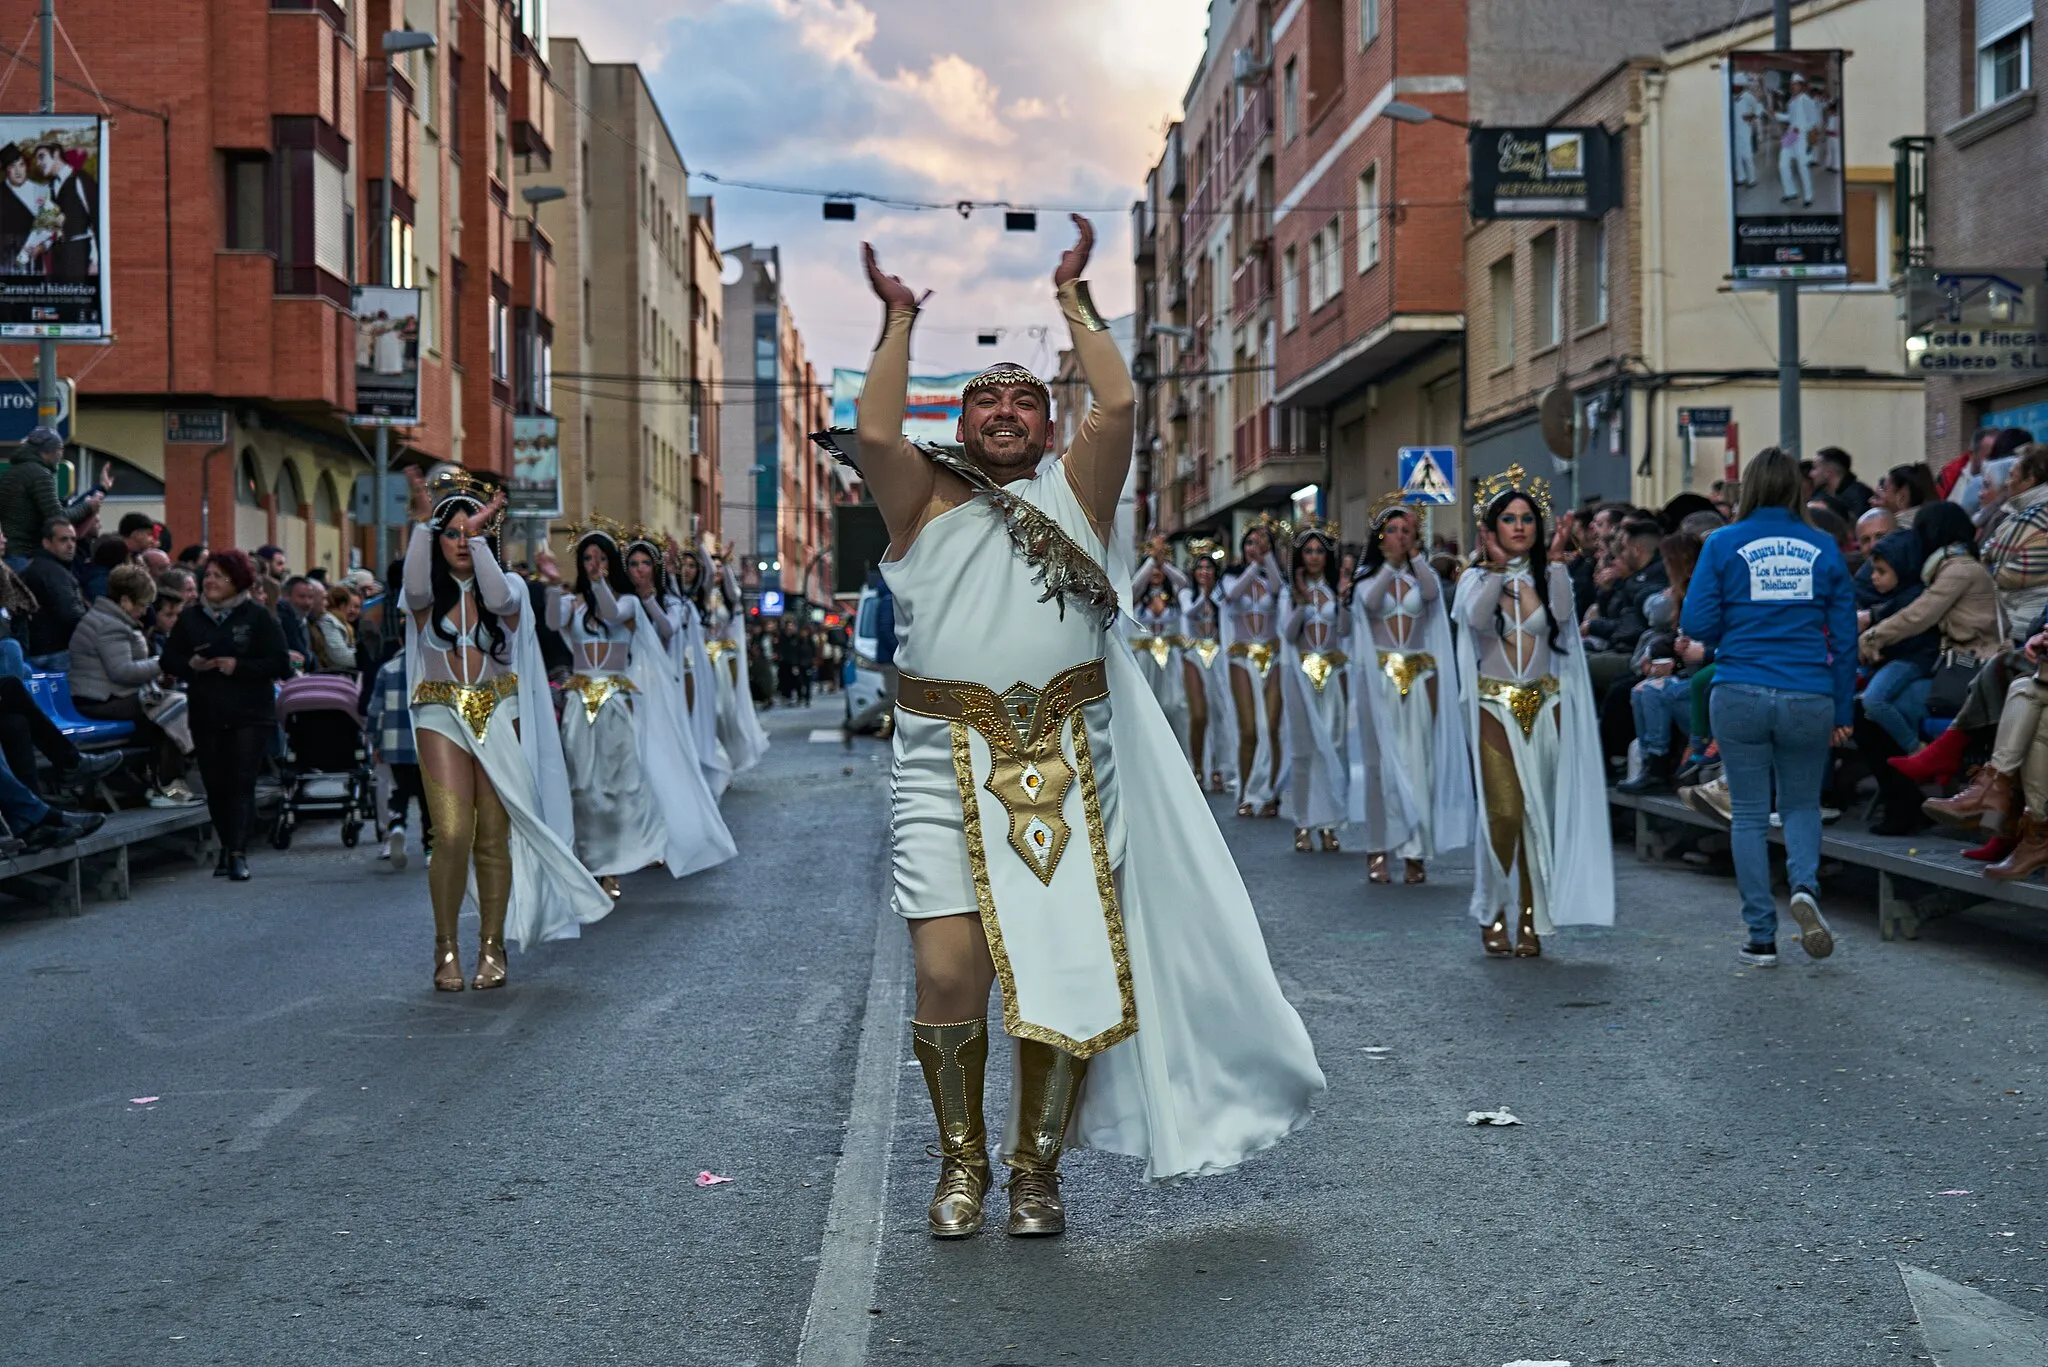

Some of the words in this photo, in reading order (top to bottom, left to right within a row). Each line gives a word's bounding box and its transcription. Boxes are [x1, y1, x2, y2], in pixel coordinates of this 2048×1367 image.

[1739, 224, 1788, 236] Carnaval
[47, 282, 96, 295] histórico
[1921, 354, 1996, 369] Cabezo
[0, 393, 34, 409] ros
[1773, 565, 1810, 577] Arrimaos
